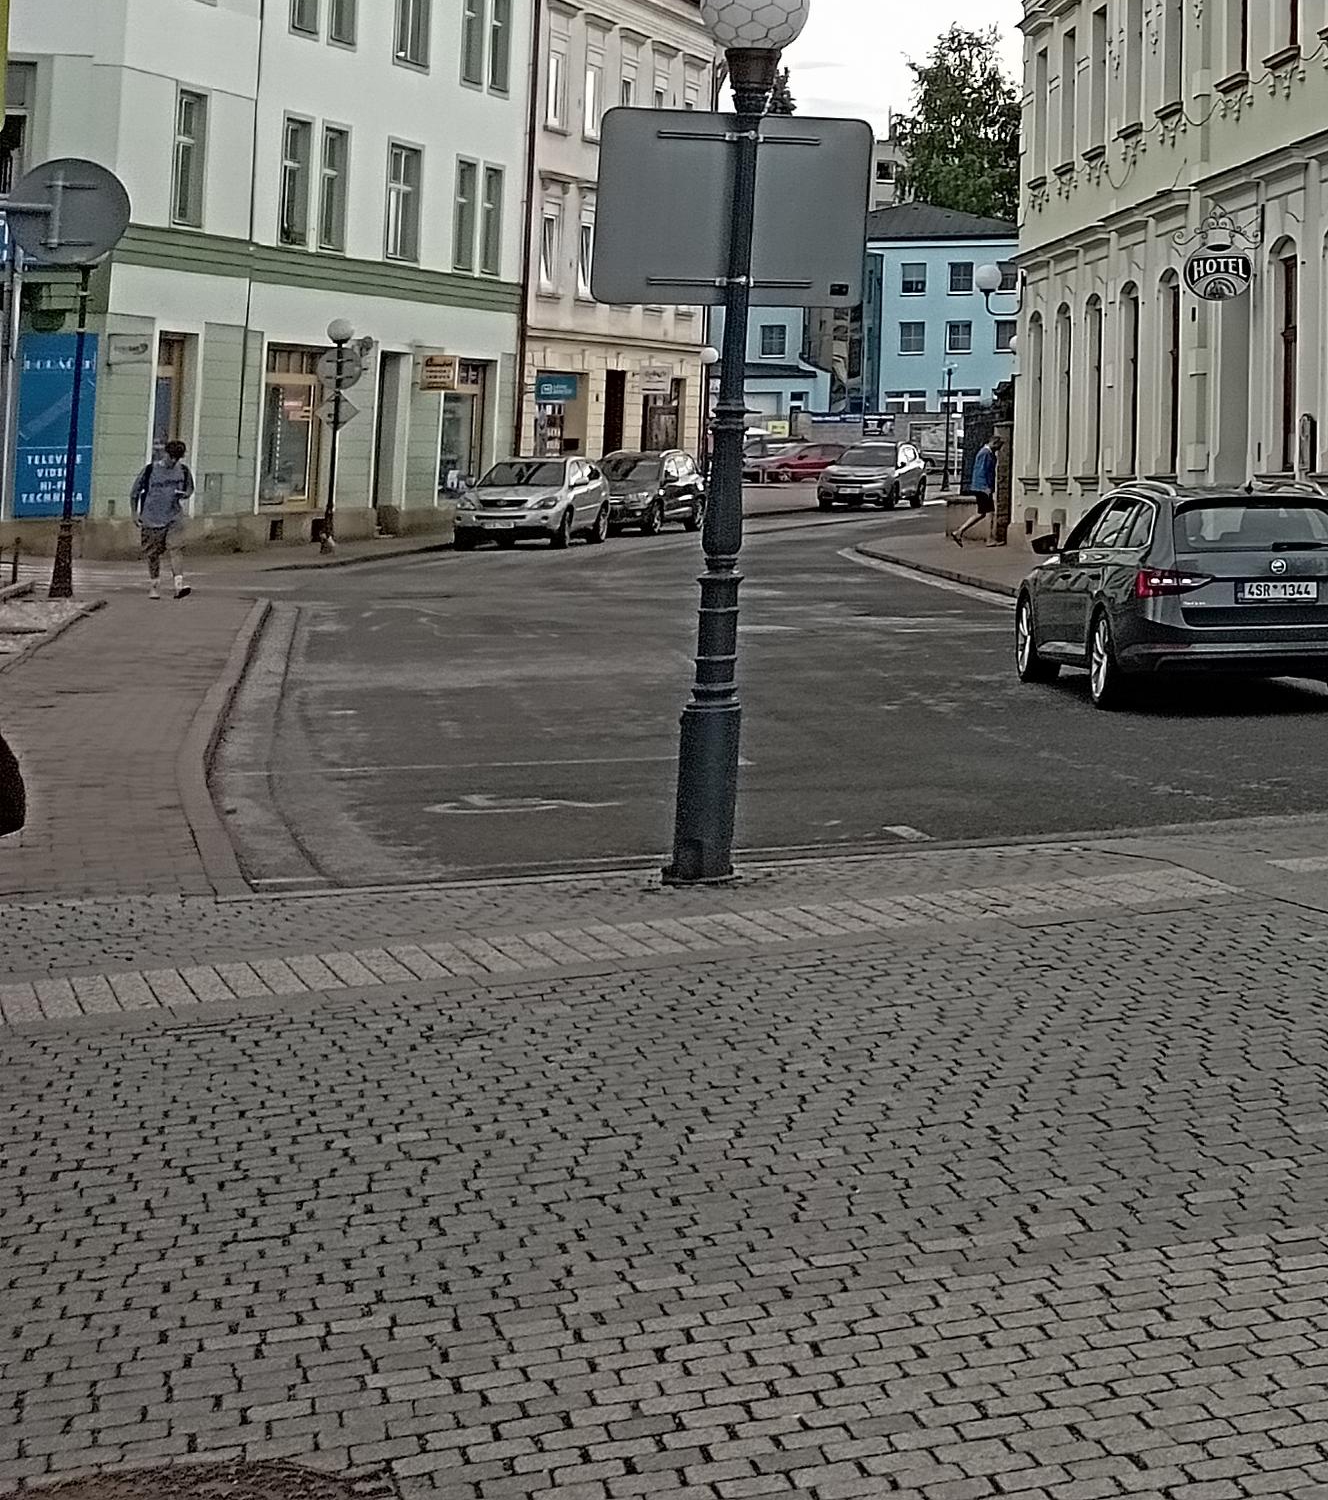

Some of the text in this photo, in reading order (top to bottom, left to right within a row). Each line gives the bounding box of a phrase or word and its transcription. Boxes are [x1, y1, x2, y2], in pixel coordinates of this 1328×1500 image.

[1193, 258, 1248, 281] HOTEL
[27, 454, 82, 465] TELEVIE
[21, 492, 83, 503] TECHNIA
[1247, 584, 1311, 597] 4SR 1344
